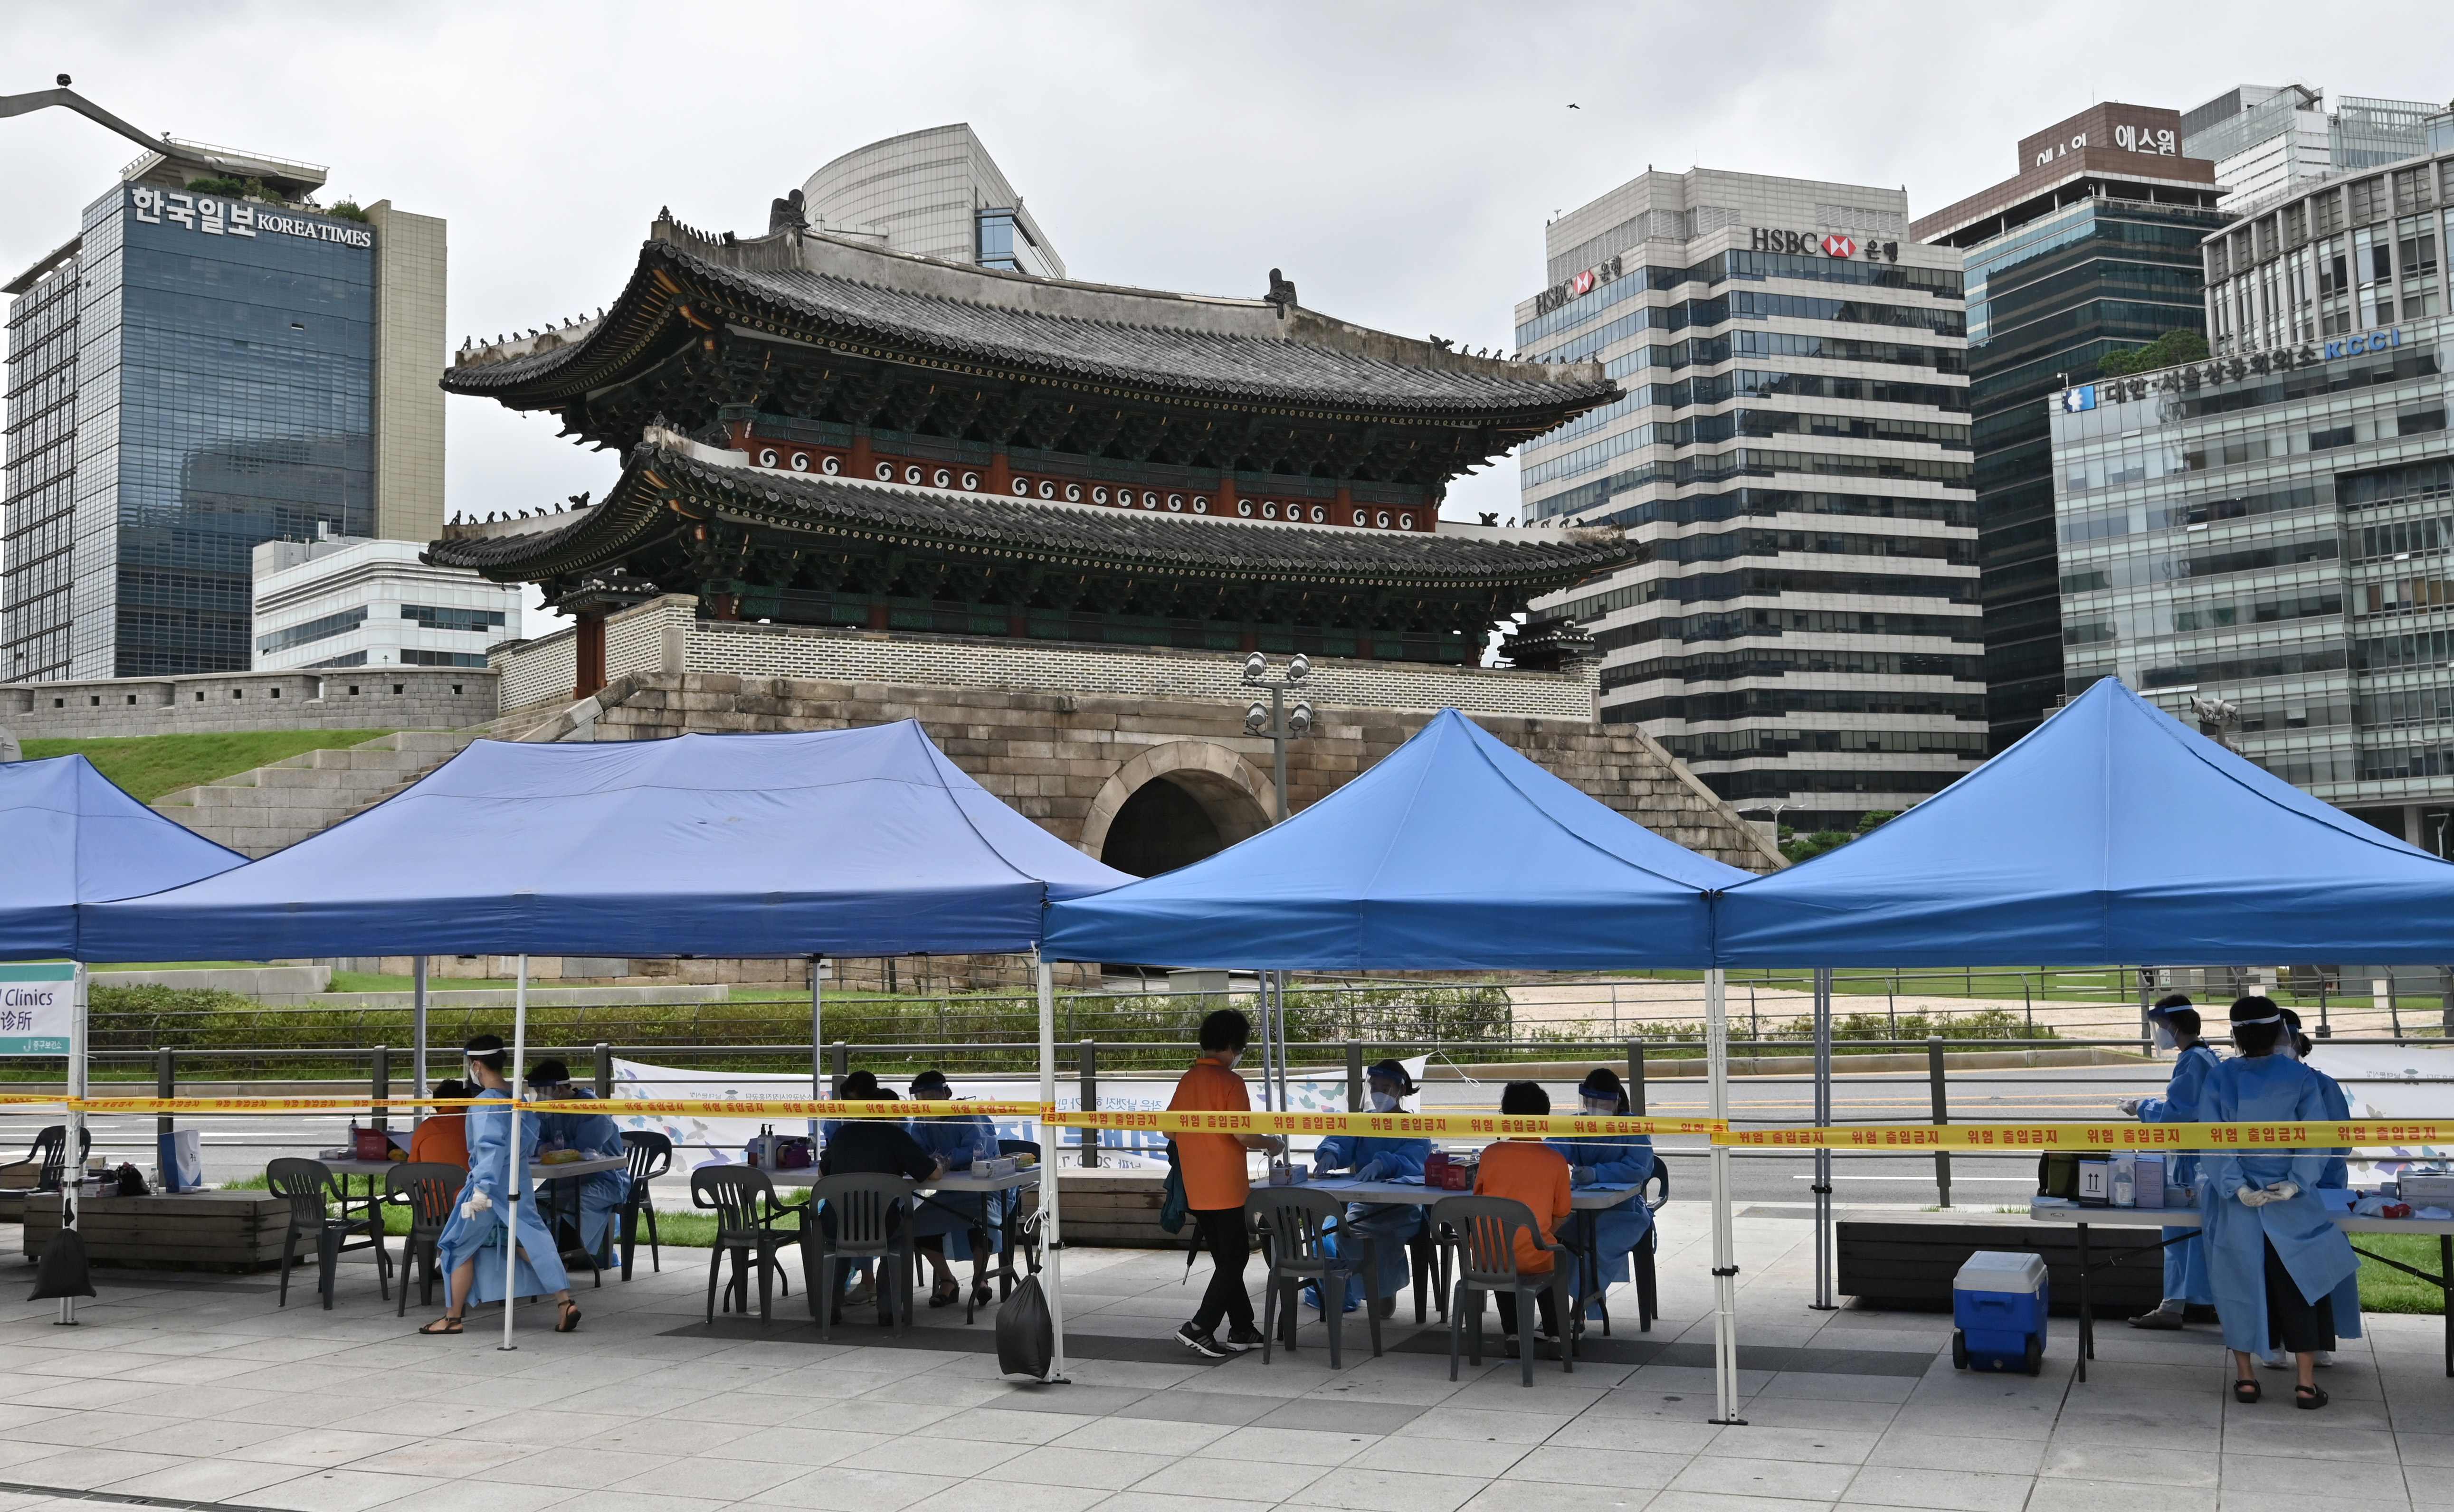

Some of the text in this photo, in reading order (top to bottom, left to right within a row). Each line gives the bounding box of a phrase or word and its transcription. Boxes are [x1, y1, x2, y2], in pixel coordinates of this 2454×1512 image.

[2115, 125, 2176, 157] 에스원
[133, 187, 371, 247] 한국일보 KOREA TIMES
[1751, 227, 1898, 262] HSBC 은행
[1535, 255, 1621, 316] HSBC 은행
[2324, 329, 2400, 359] KCCI
[5, 988, 53, 1006] Clinics
[0, 1011, 32, 1031] 诊所
[625, 1102, 684, 1112] 위험 출입금지
[702, 1103, 764, 1113] 위험 출입금지
[783, 1103, 846, 1114] 위험 출입금지
[866, 1105, 931, 1114] 위험 출입금지
[1089, 1114, 1157, 1127] 위험 출입금지
[1180, 1115, 1250, 1128] 위험 출입금지
[1275, 1117, 1347, 1130] 위험 출입금지
[1372, 1118, 1446, 1132] 위험 출입금지
[1471, 1119, 1548, 1133] 위험 출입금지
[1575, 1122, 1655, 1134] 위험 출입금지
[2339, 1126, 2436, 1141] 위험 출입금지
[1740, 1132, 1824, 1144] 위험 출입금지
[1852, 1131, 1938, 1145] 위험 출입금지
[1969, 1130, 2057, 1144] 위험 출입금지
[2089, 1130, 2179, 1143] 위험 출입금지
[2211, 1129, 2305, 1143] 위험 출입금지
